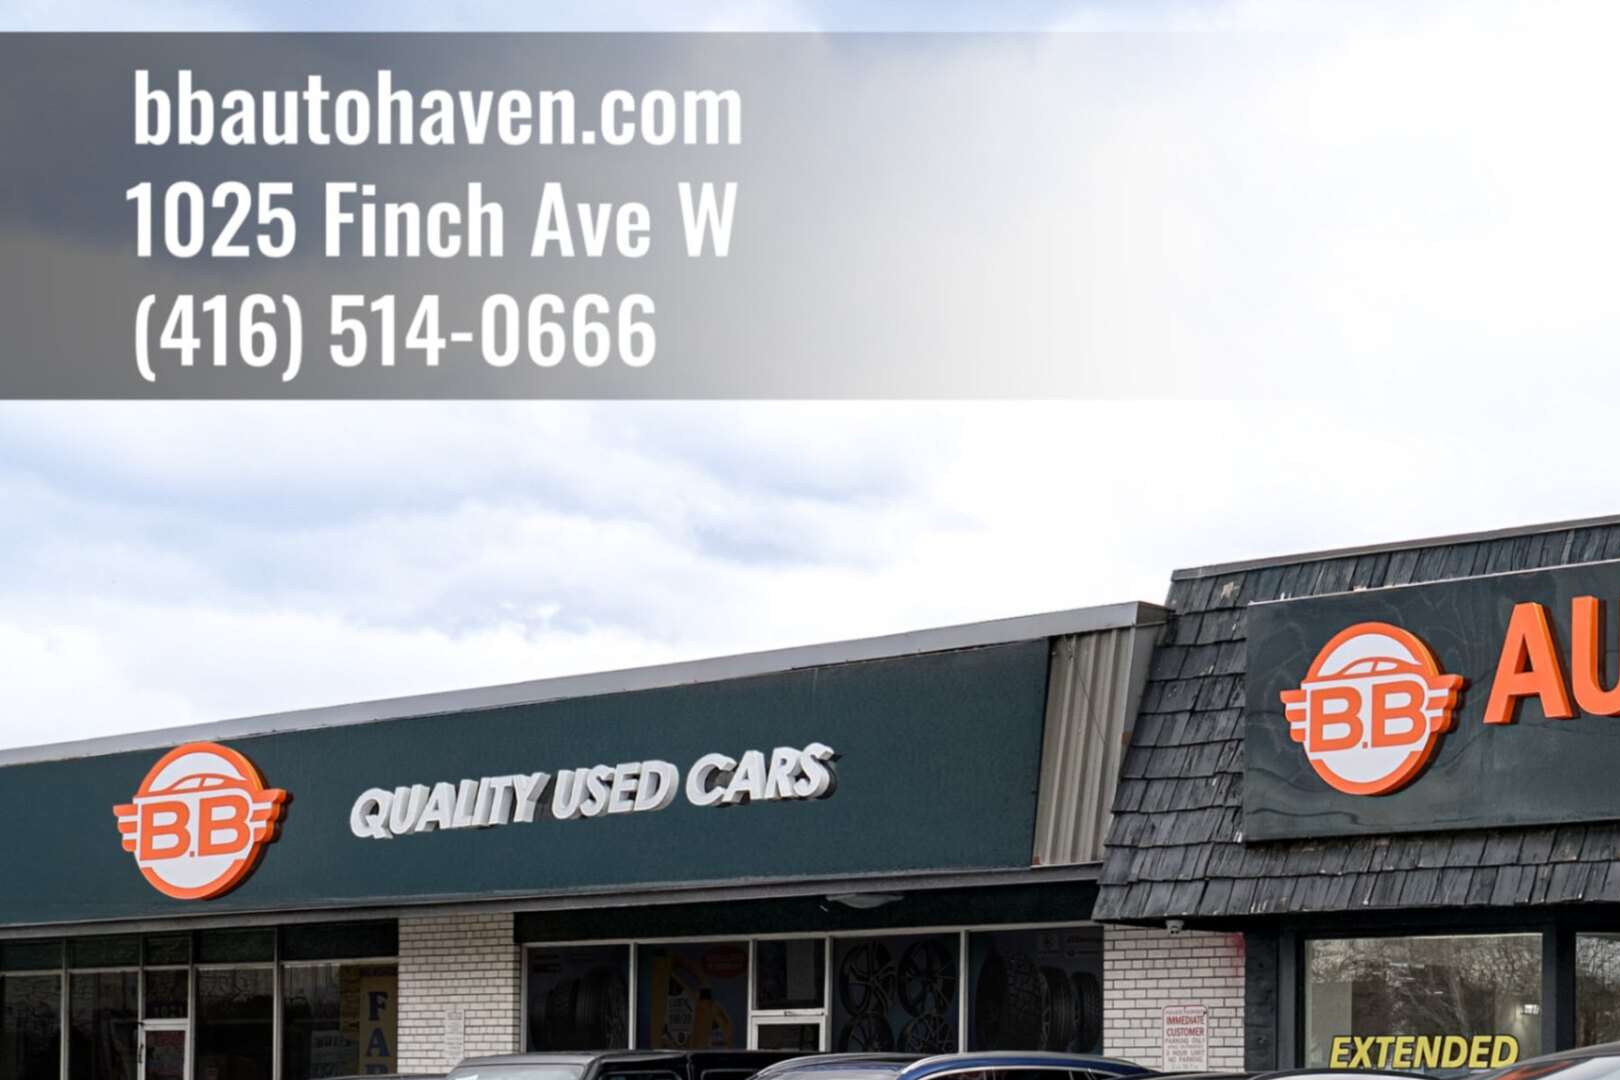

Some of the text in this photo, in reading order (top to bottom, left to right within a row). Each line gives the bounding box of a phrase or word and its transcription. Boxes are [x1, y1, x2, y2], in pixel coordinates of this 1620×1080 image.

[350, 742, 836, 840] QUALITY USED CARS
[1166, 1016, 1205, 1025] IMMEDIATE
[1166, 1027, 1205, 1037] CUSTOMER
[1329, 1034, 1520, 1070] EXTENDED
